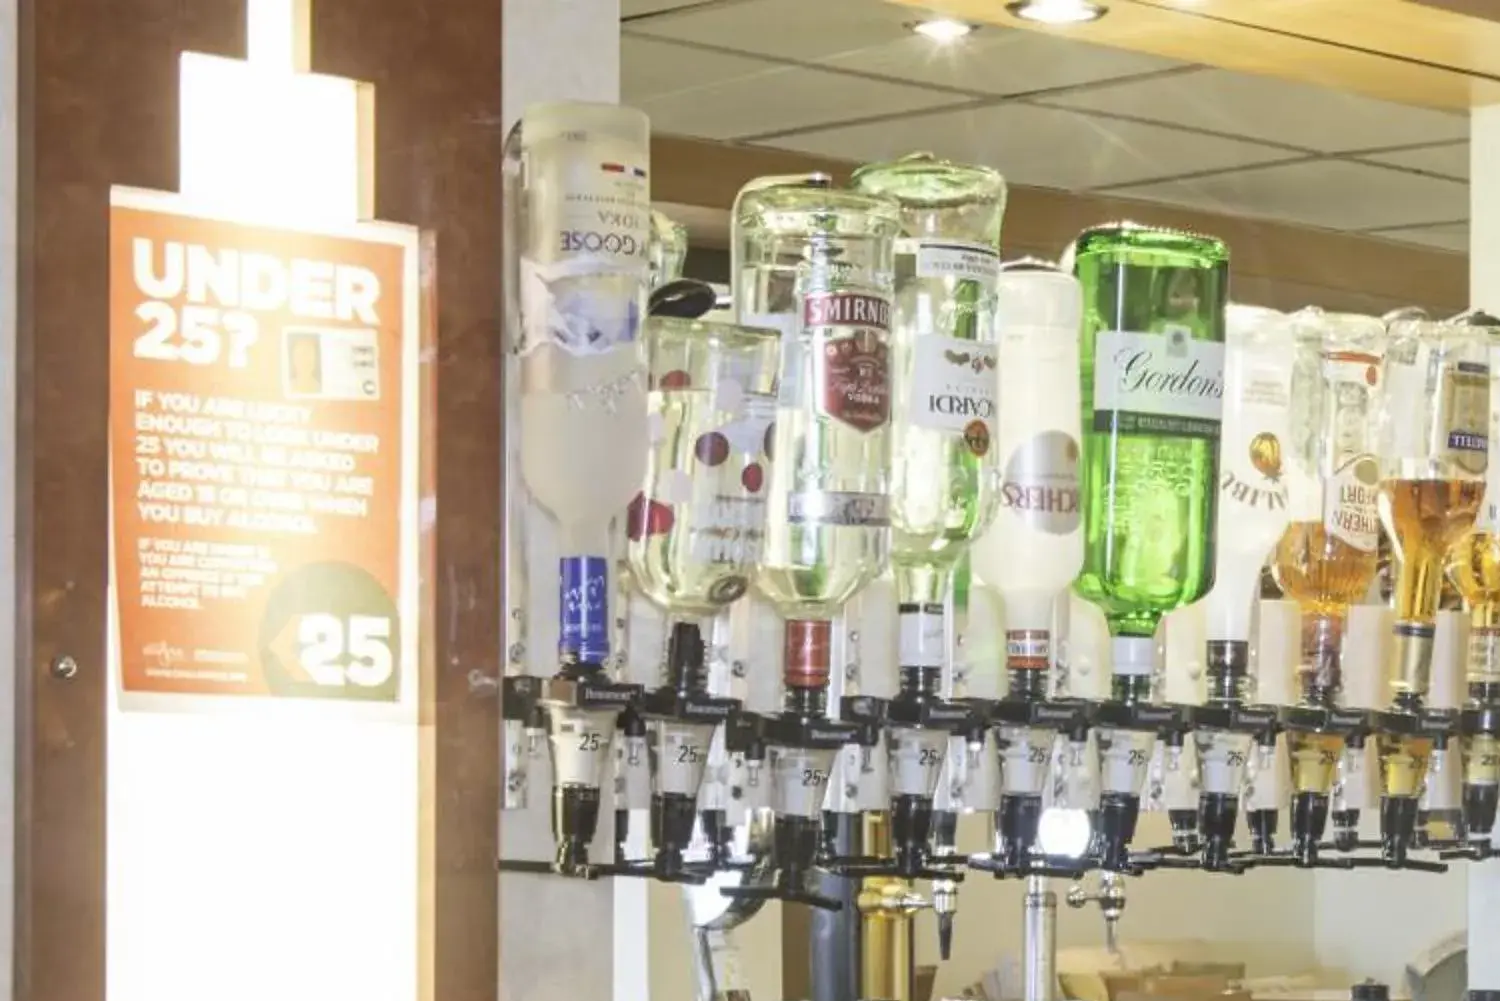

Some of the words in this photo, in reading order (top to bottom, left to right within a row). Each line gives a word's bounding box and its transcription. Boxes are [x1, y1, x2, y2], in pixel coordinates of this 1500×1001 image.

[559, 231, 636, 256] GOOSE
[132, 236, 382, 327] UNDER
[132, 300, 259, 369] 25?
[157, 391, 201, 412] YOU
[135, 436, 162, 454] 25
[162, 438, 207, 459] YOU
[137, 458, 166, 477] TO
[137, 502, 181, 523] YOU
[299, 612, 393, 688] 25
[579, 733, 599, 751] 25
[678, 745, 698, 763] 25
[919, 750, 937, 766] 25
[1029, 746, 1046, 762] 25
[1129, 750, 1147, 765] 25
[804, 769, 823, 786] 25
